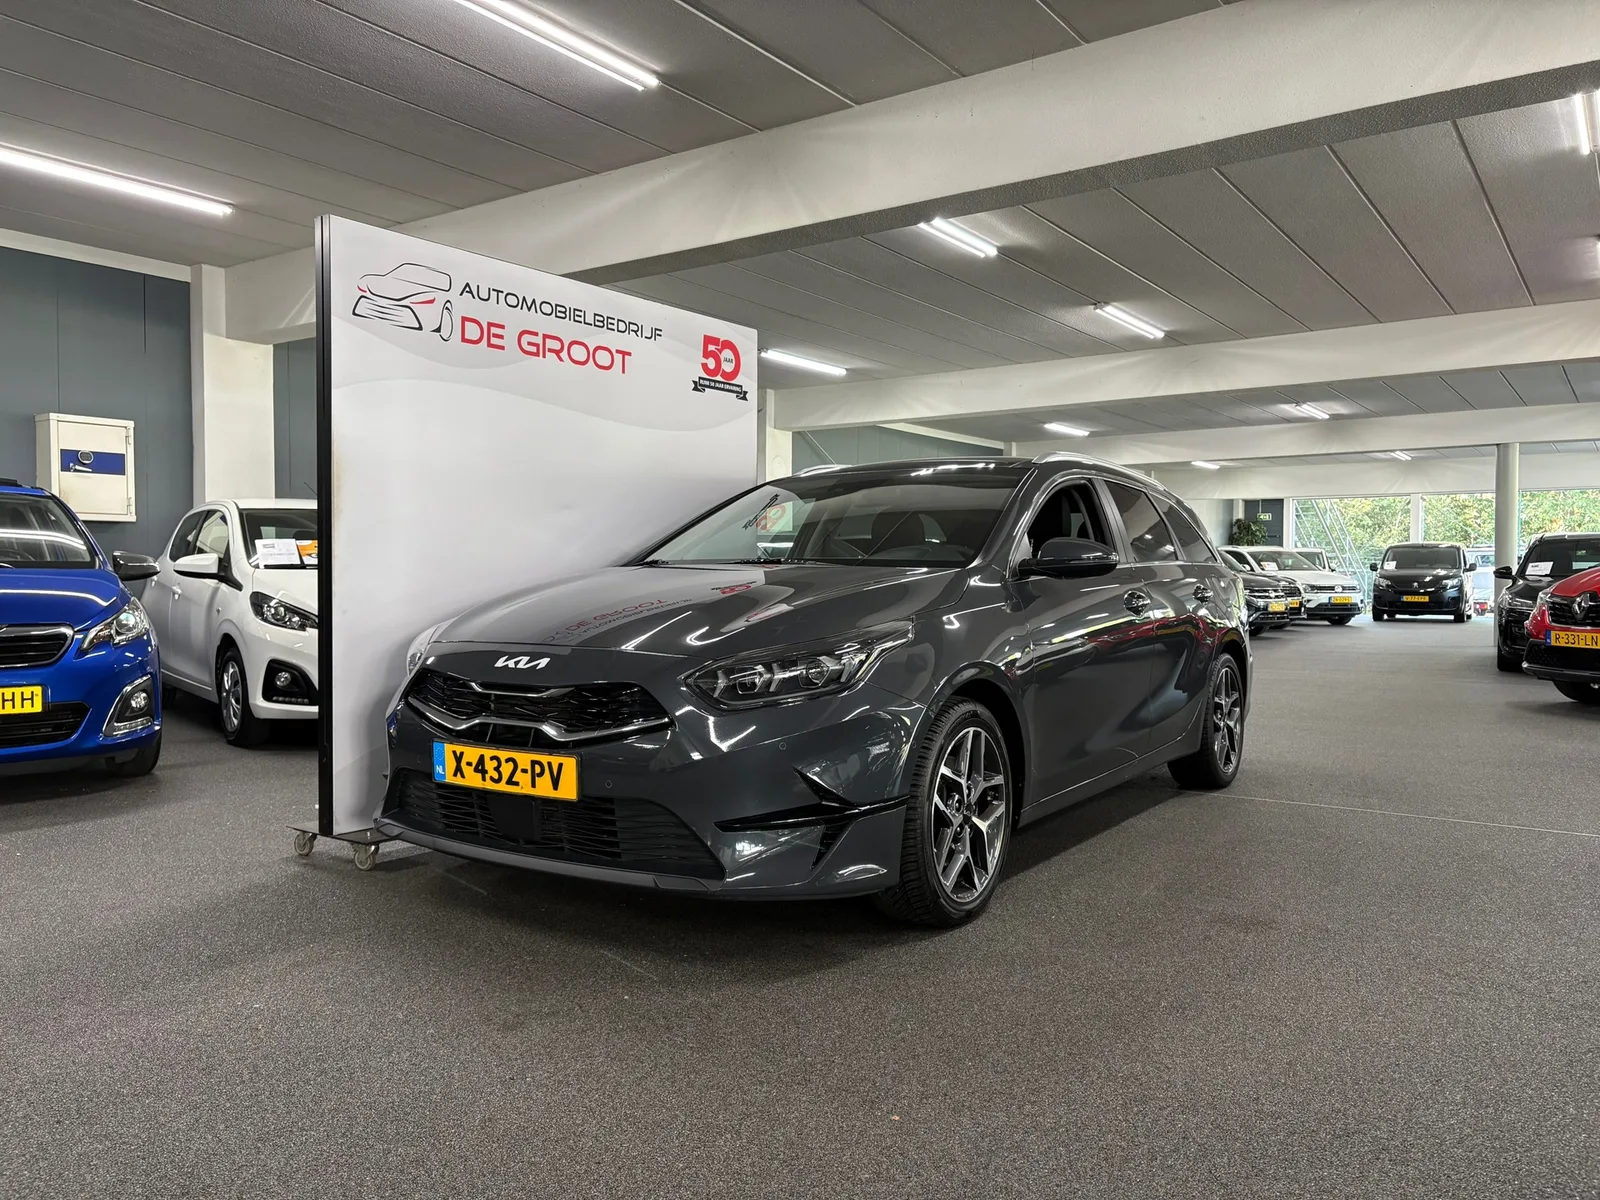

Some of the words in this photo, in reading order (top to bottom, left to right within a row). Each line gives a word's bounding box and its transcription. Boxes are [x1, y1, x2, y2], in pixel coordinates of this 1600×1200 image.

[459, 281, 663, 342] AUTOMOBIELBEDRIJF
[460, 315, 506, 351] DE
[517, 329, 632, 375] GROOT
[701, 334, 741, 382] 50
[1555, 633, 1598, 647] R-331-LN
[436, 766, 445, 775] NL
[452, 750, 564, 791] X-432-PV
